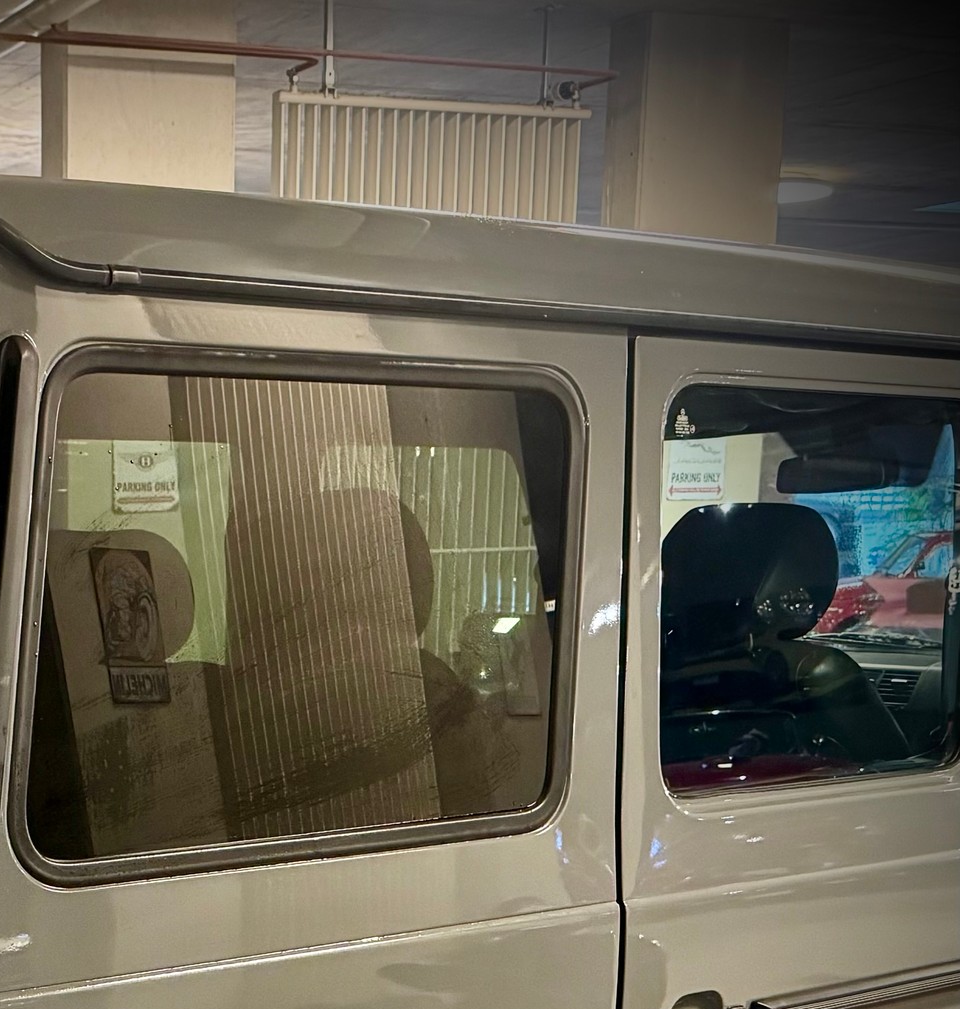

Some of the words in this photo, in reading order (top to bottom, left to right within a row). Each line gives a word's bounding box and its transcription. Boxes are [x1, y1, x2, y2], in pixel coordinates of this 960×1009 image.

[671, 472, 701, 483] PARKING
[703, 472, 721, 483] ONLY
[117, 481, 153, 492] PARKING
[154, 481, 175, 492] ONLY
